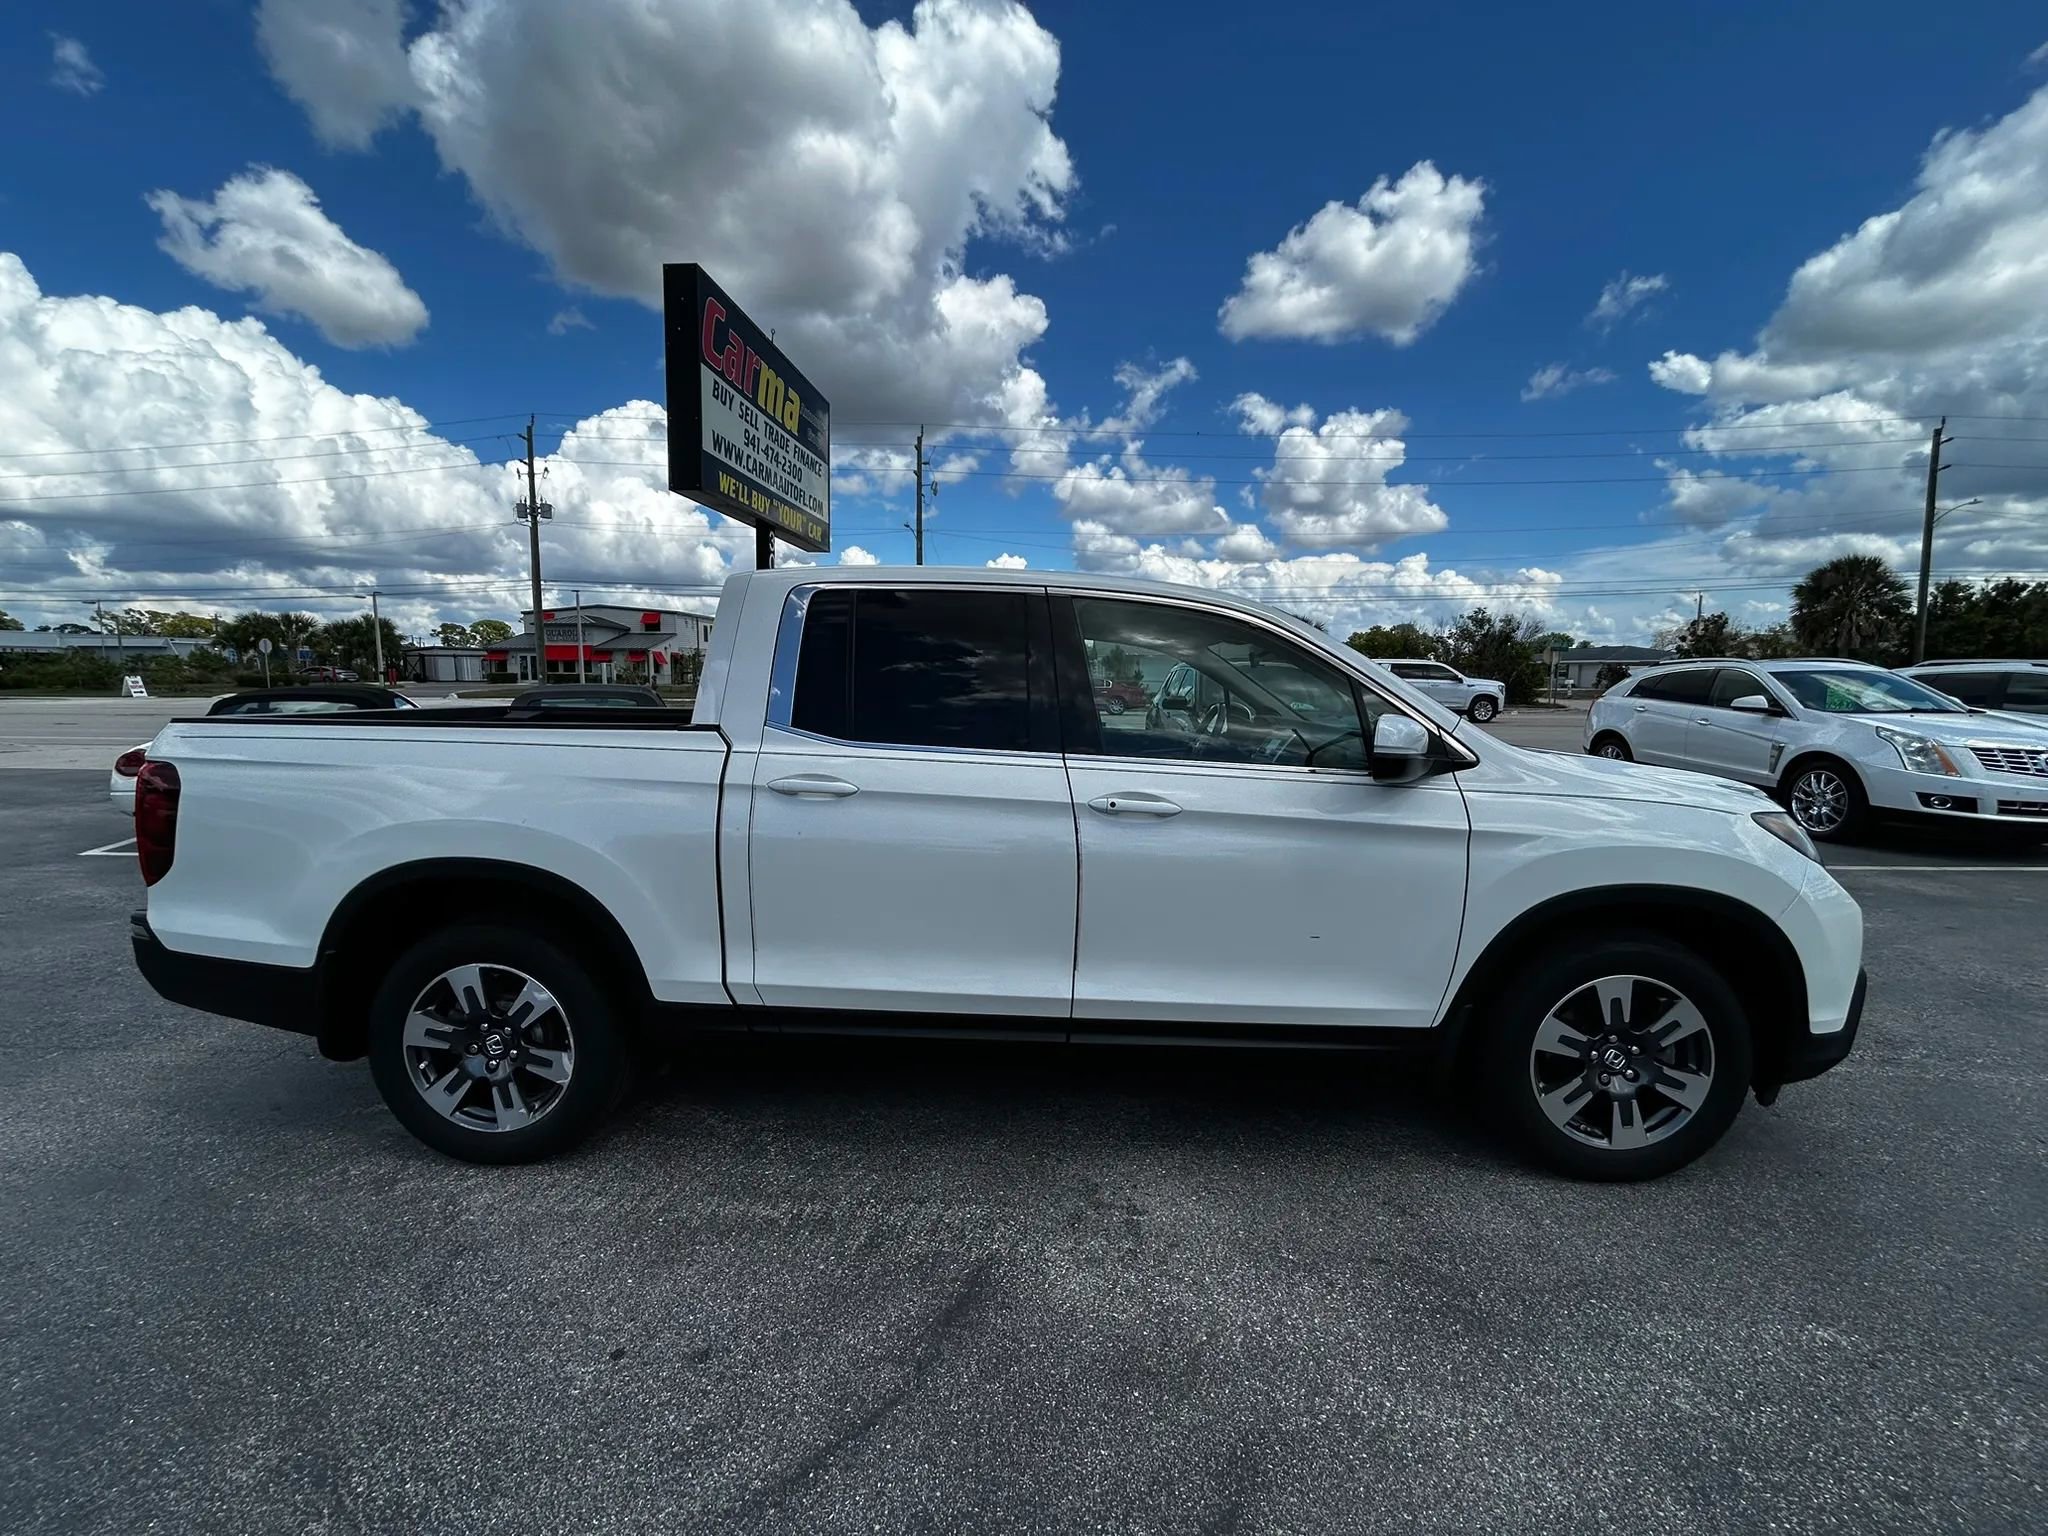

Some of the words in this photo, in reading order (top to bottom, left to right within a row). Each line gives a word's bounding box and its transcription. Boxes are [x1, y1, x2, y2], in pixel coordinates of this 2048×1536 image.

[702, 297, 800, 436] Carma
[712, 378, 734, 411] BUY
[738, 401, 759, 431] SELL
[764, 421, 790, 454] TRADE
[793, 445, 822, 477] FINANCE
[743, 428, 803, 483] 941-474-2300
[712, 429, 824, 516] WWW.CARMAAUTOFL.COM
[719, 471, 749, 505] WE'LL
[751, 489, 771, 515] BUY
[808, 522, 822, 541] CAR
